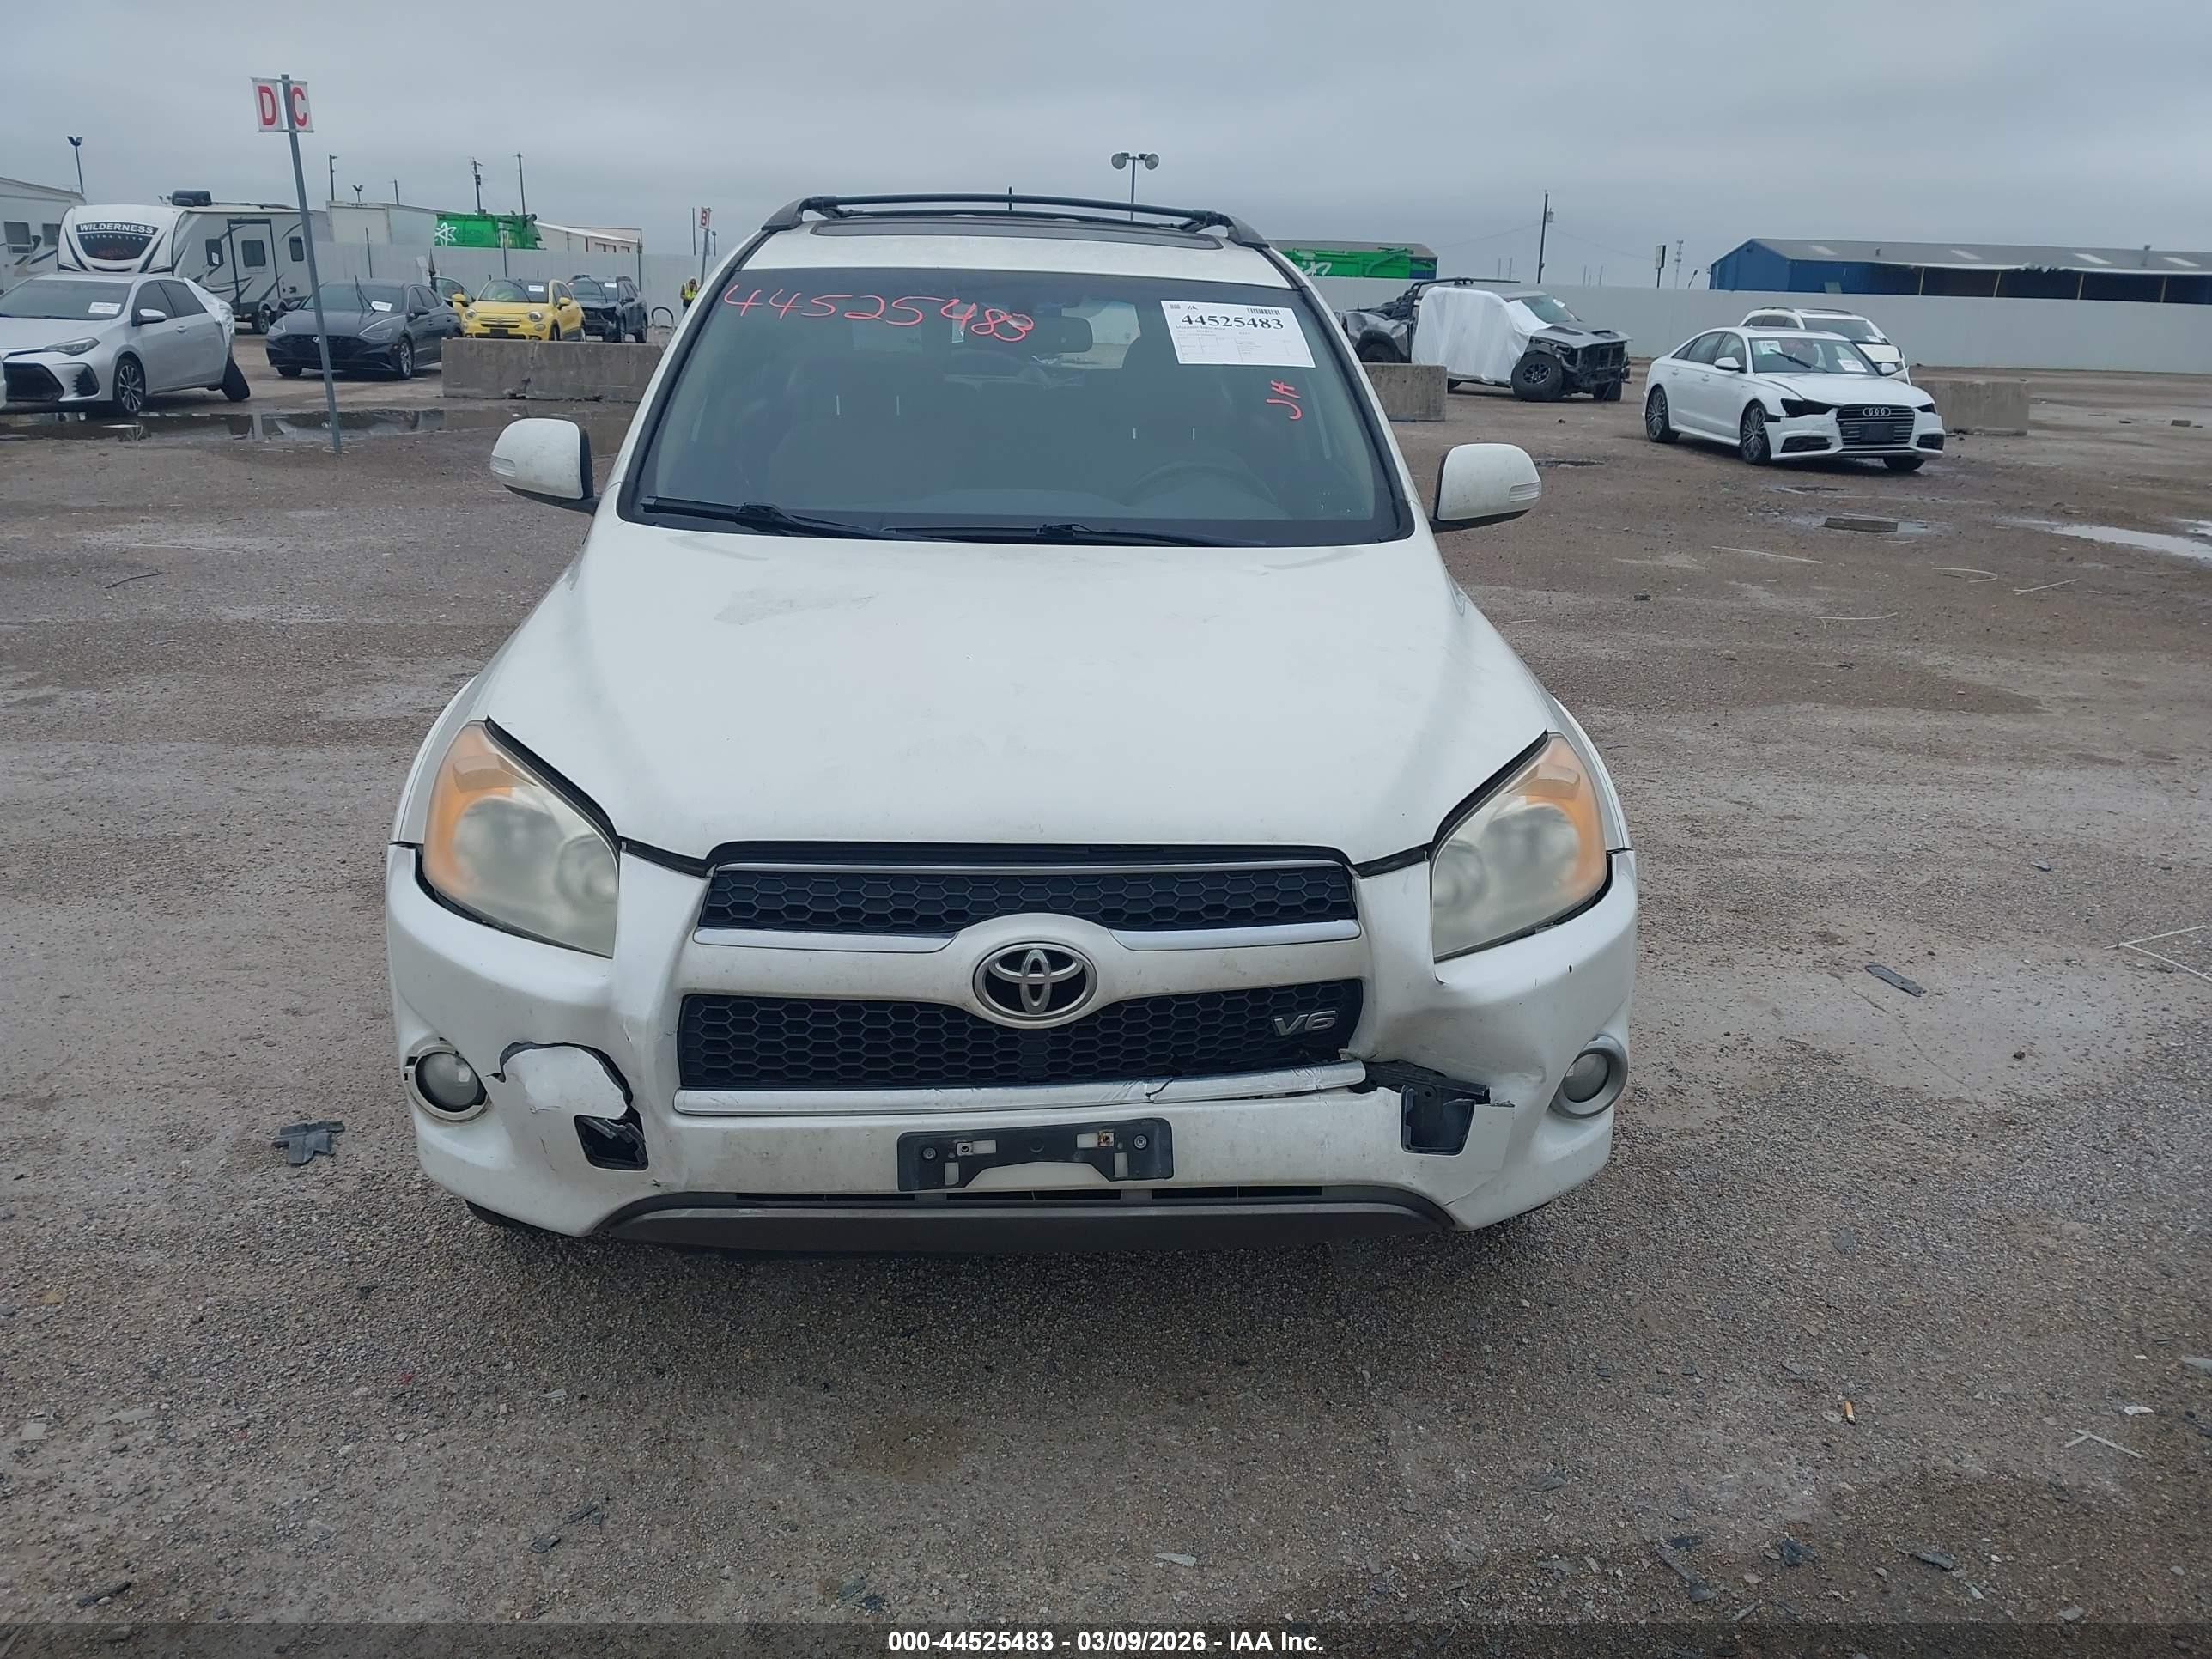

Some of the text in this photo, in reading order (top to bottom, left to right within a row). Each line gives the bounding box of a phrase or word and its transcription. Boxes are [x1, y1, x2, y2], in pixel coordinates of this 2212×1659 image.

[258, 86, 276, 125] D
[290, 87, 307, 127] C
[79, 223, 154, 234] WILDERNESS
[724, 284, 1034, 342] 44525483
[1181, 314, 1284, 330] 44525483
[1273, 1010, 1336, 1036] V6
